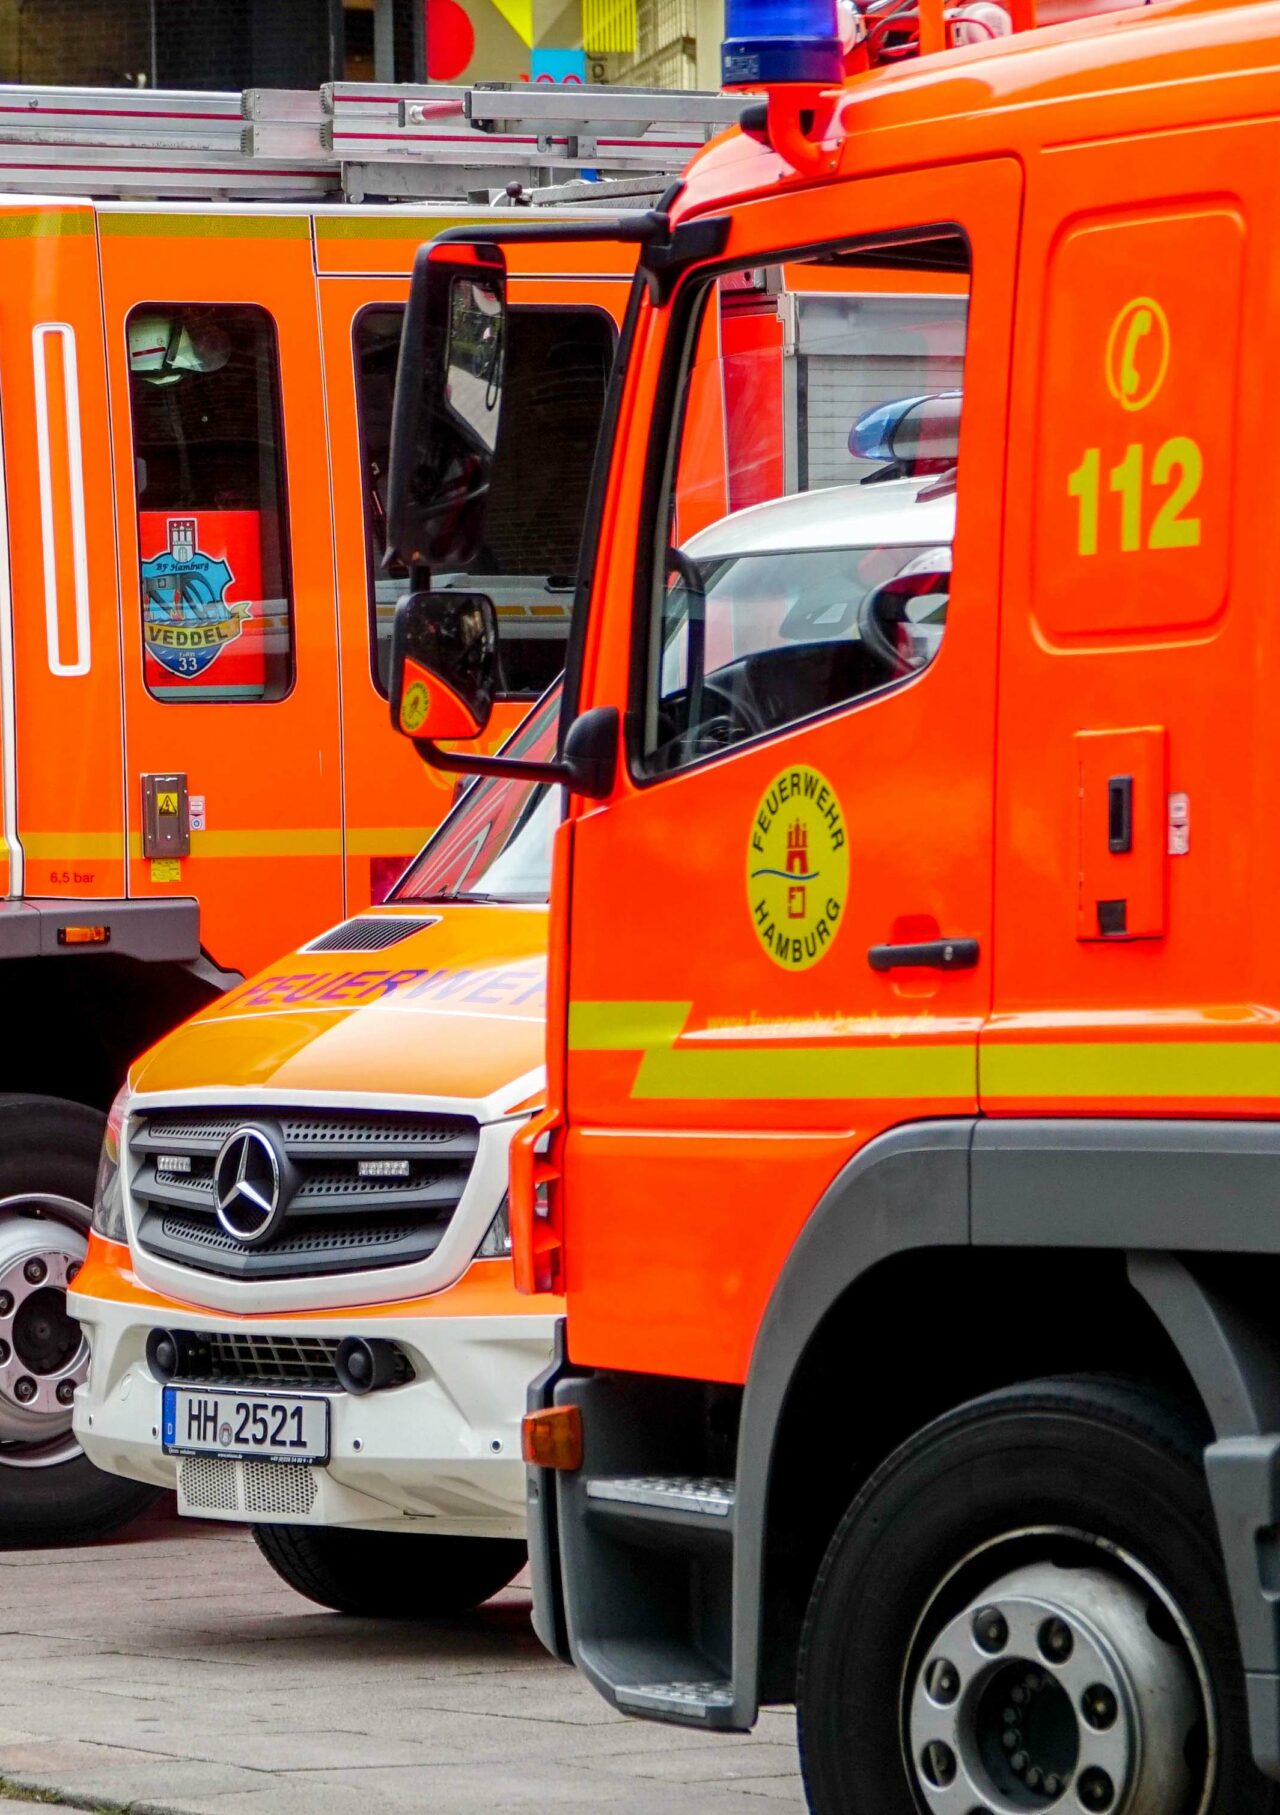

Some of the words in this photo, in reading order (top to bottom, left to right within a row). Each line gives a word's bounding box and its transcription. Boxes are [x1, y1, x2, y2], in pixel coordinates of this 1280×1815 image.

[1068, 436, 1203, 556] 112
[170, 561, 210, 573] Hamburg
[148, 625, 228, 646] VEDDEL
[178, 657, 198, 671] 33
[752, 772, 845, 852] FEUERWEHR
[50, 871, 70, 884] 6,5
[74, 871, 95, 884] bar
[754, 897, 841, 963] HAMBURG
[187, 1398, 218, 1442] HH
[234, 1402, 308, 1449] 2521
